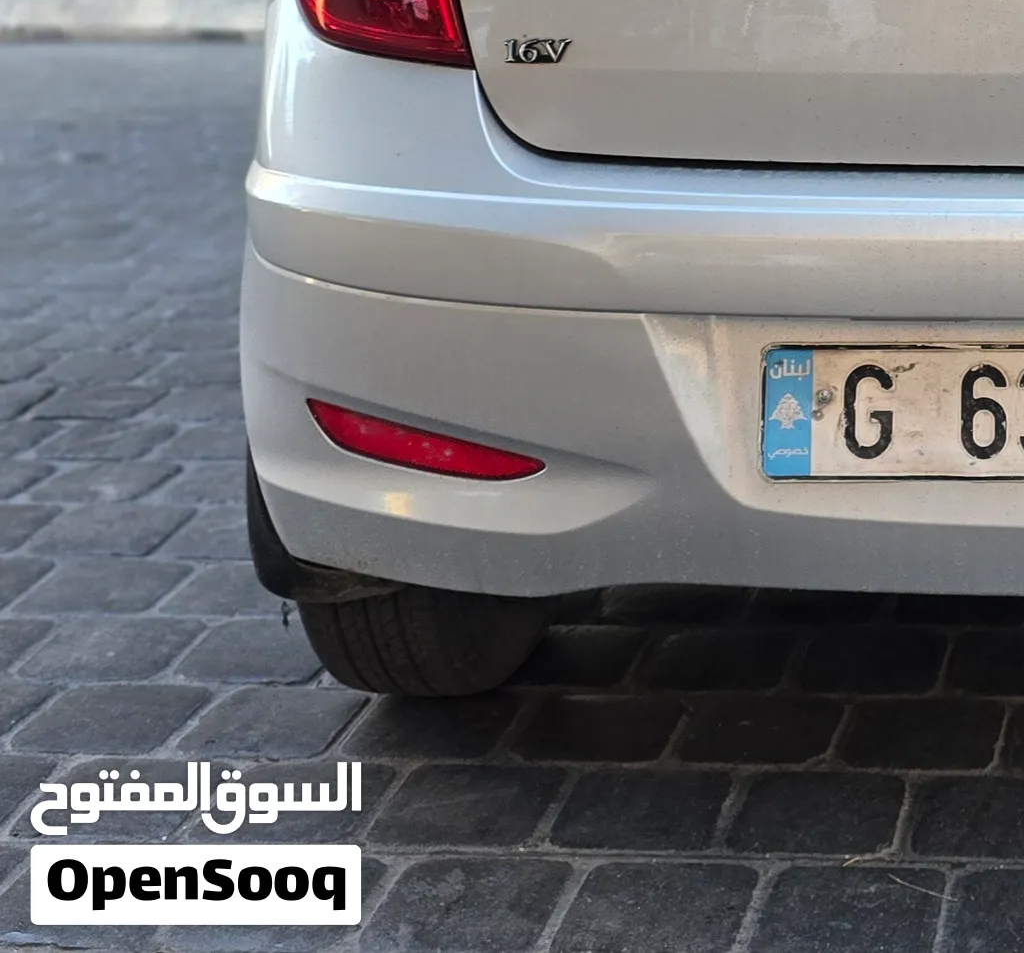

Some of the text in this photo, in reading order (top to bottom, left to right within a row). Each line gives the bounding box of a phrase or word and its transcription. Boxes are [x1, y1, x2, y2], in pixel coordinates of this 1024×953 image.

[503, 38, 572, 64] 16V
[769, 358, 811, 380] لبنان
[843, 363, 895, 459] G
[767, 446, 809, 460] خصوصي
